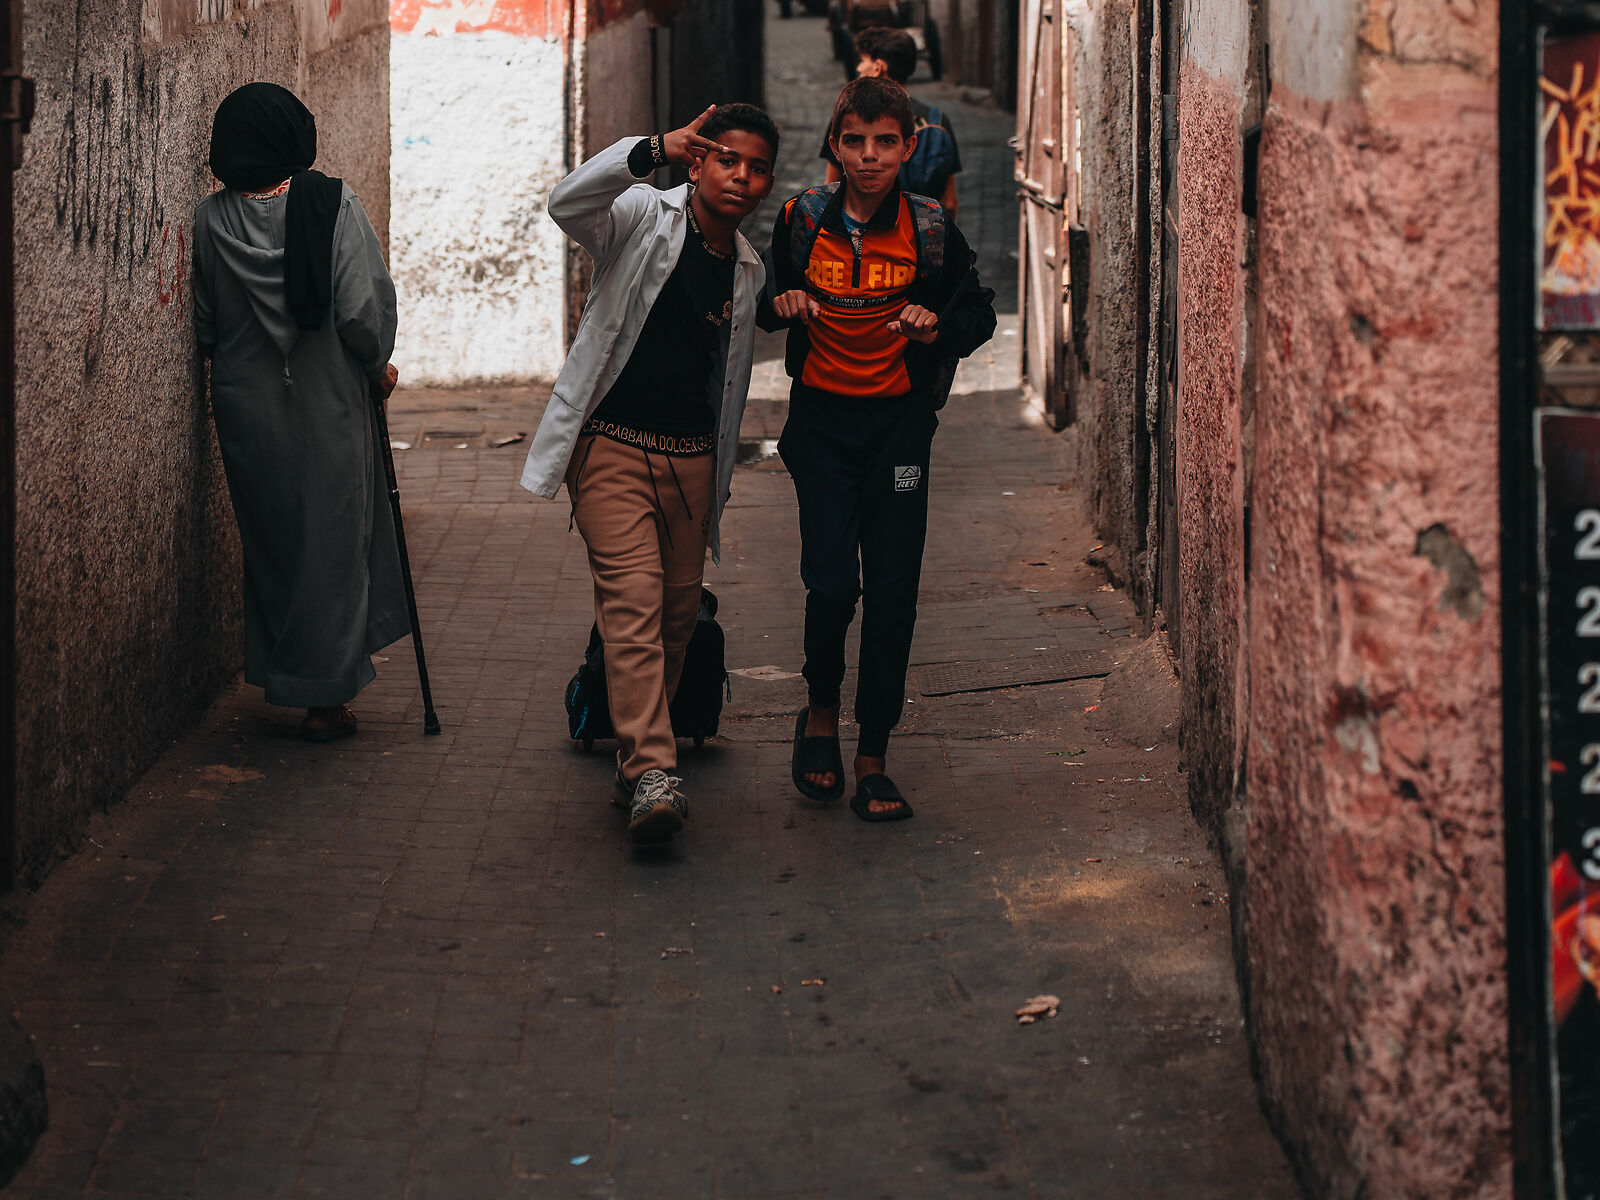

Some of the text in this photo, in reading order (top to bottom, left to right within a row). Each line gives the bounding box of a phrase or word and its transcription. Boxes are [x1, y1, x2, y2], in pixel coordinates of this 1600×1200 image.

[804, 259, 845, 289] REE
[1574, 509, 1600, 560] 2
[1576, 586, 1600, 637] 2
[1577, 662, 1600, 714] 2
